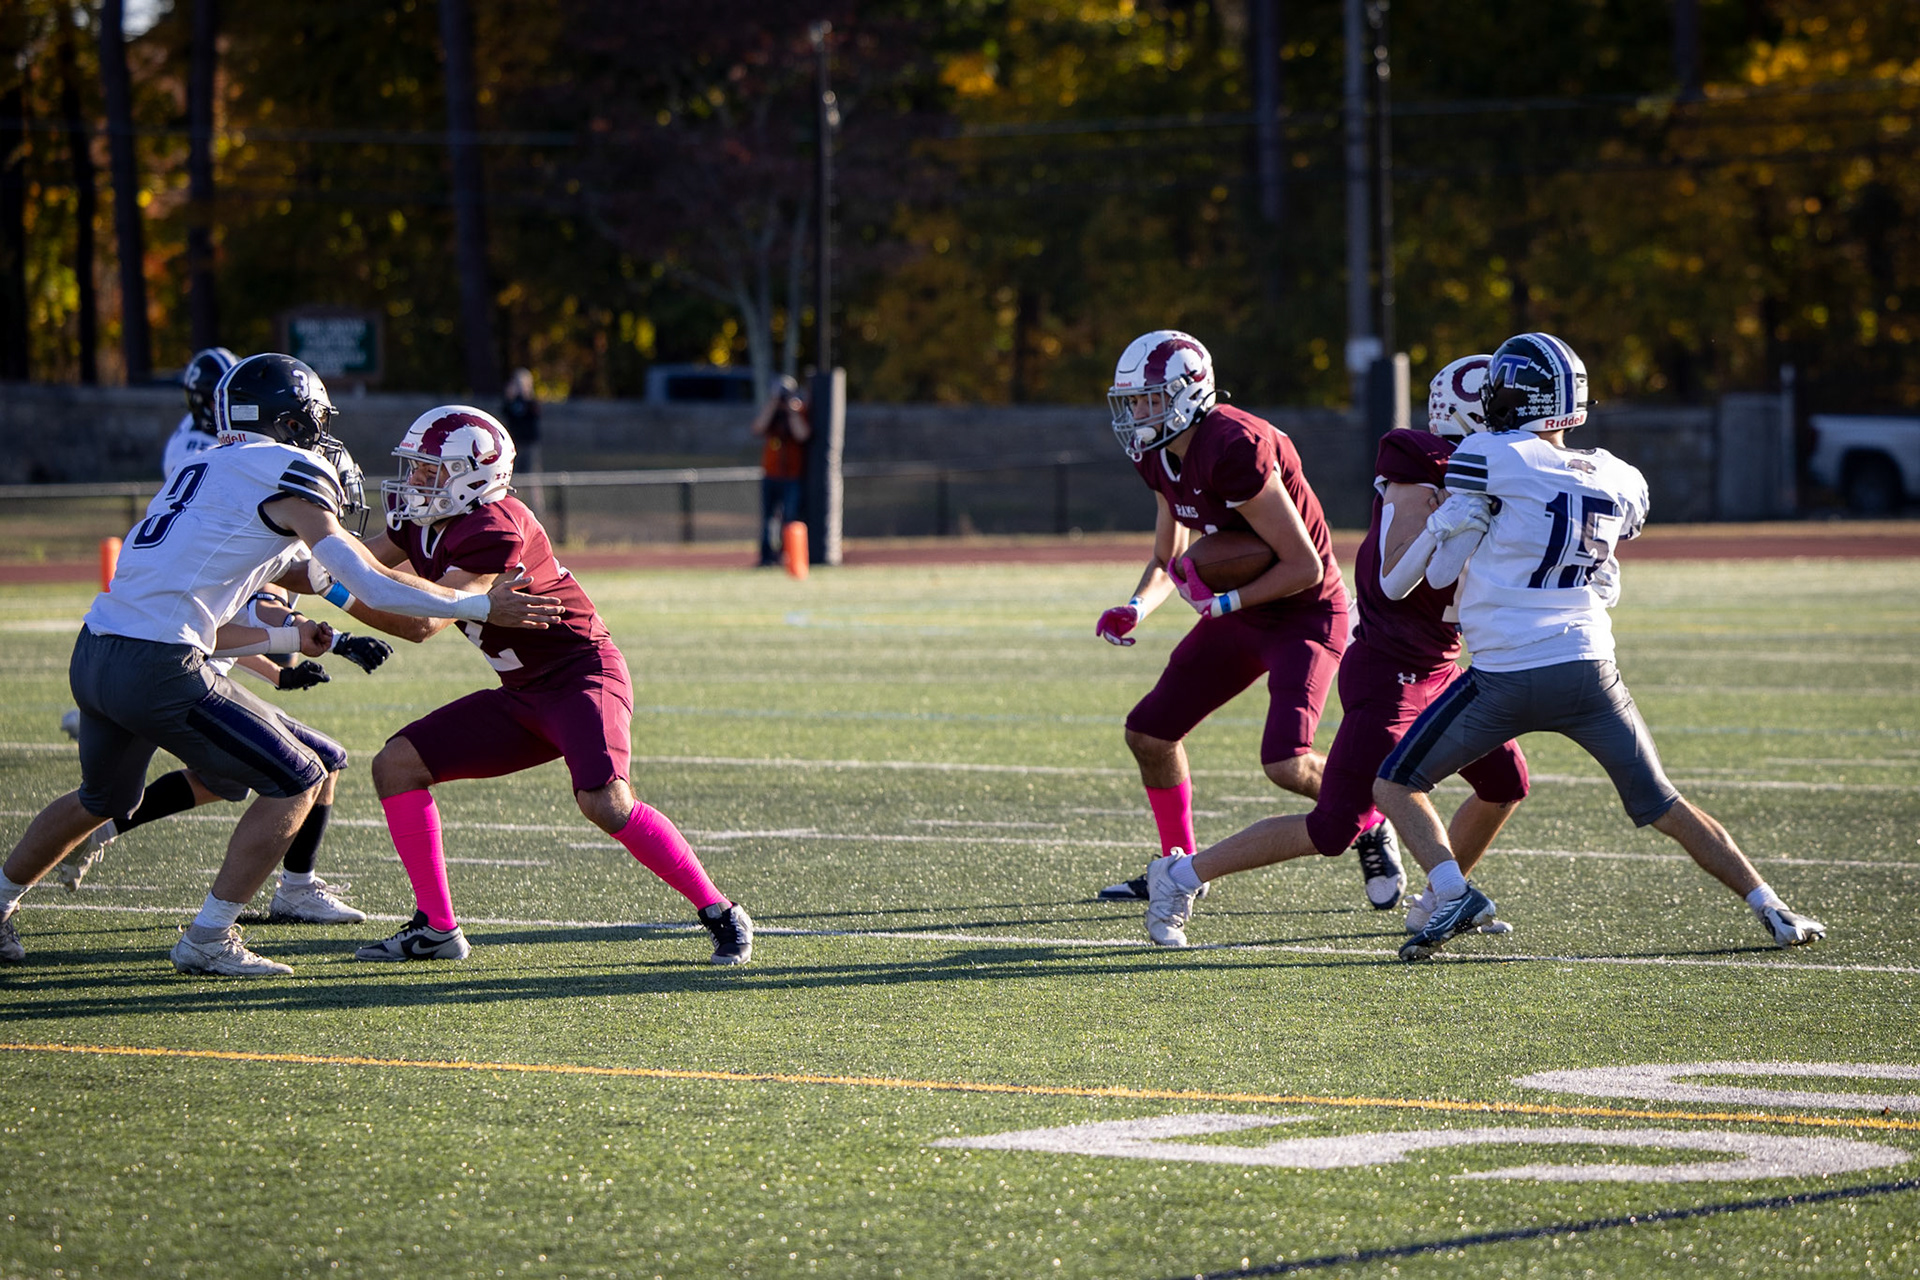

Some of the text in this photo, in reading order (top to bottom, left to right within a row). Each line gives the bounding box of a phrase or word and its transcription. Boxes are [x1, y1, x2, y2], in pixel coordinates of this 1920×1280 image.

[292, 369, 310, 399] 3
[1545, 414, 1584, 430] Riddell
[132, 462, 210, 550] 3
[1174, 503, 1199, 519] RAMS
[1527, 491, 1618, 589] 15
